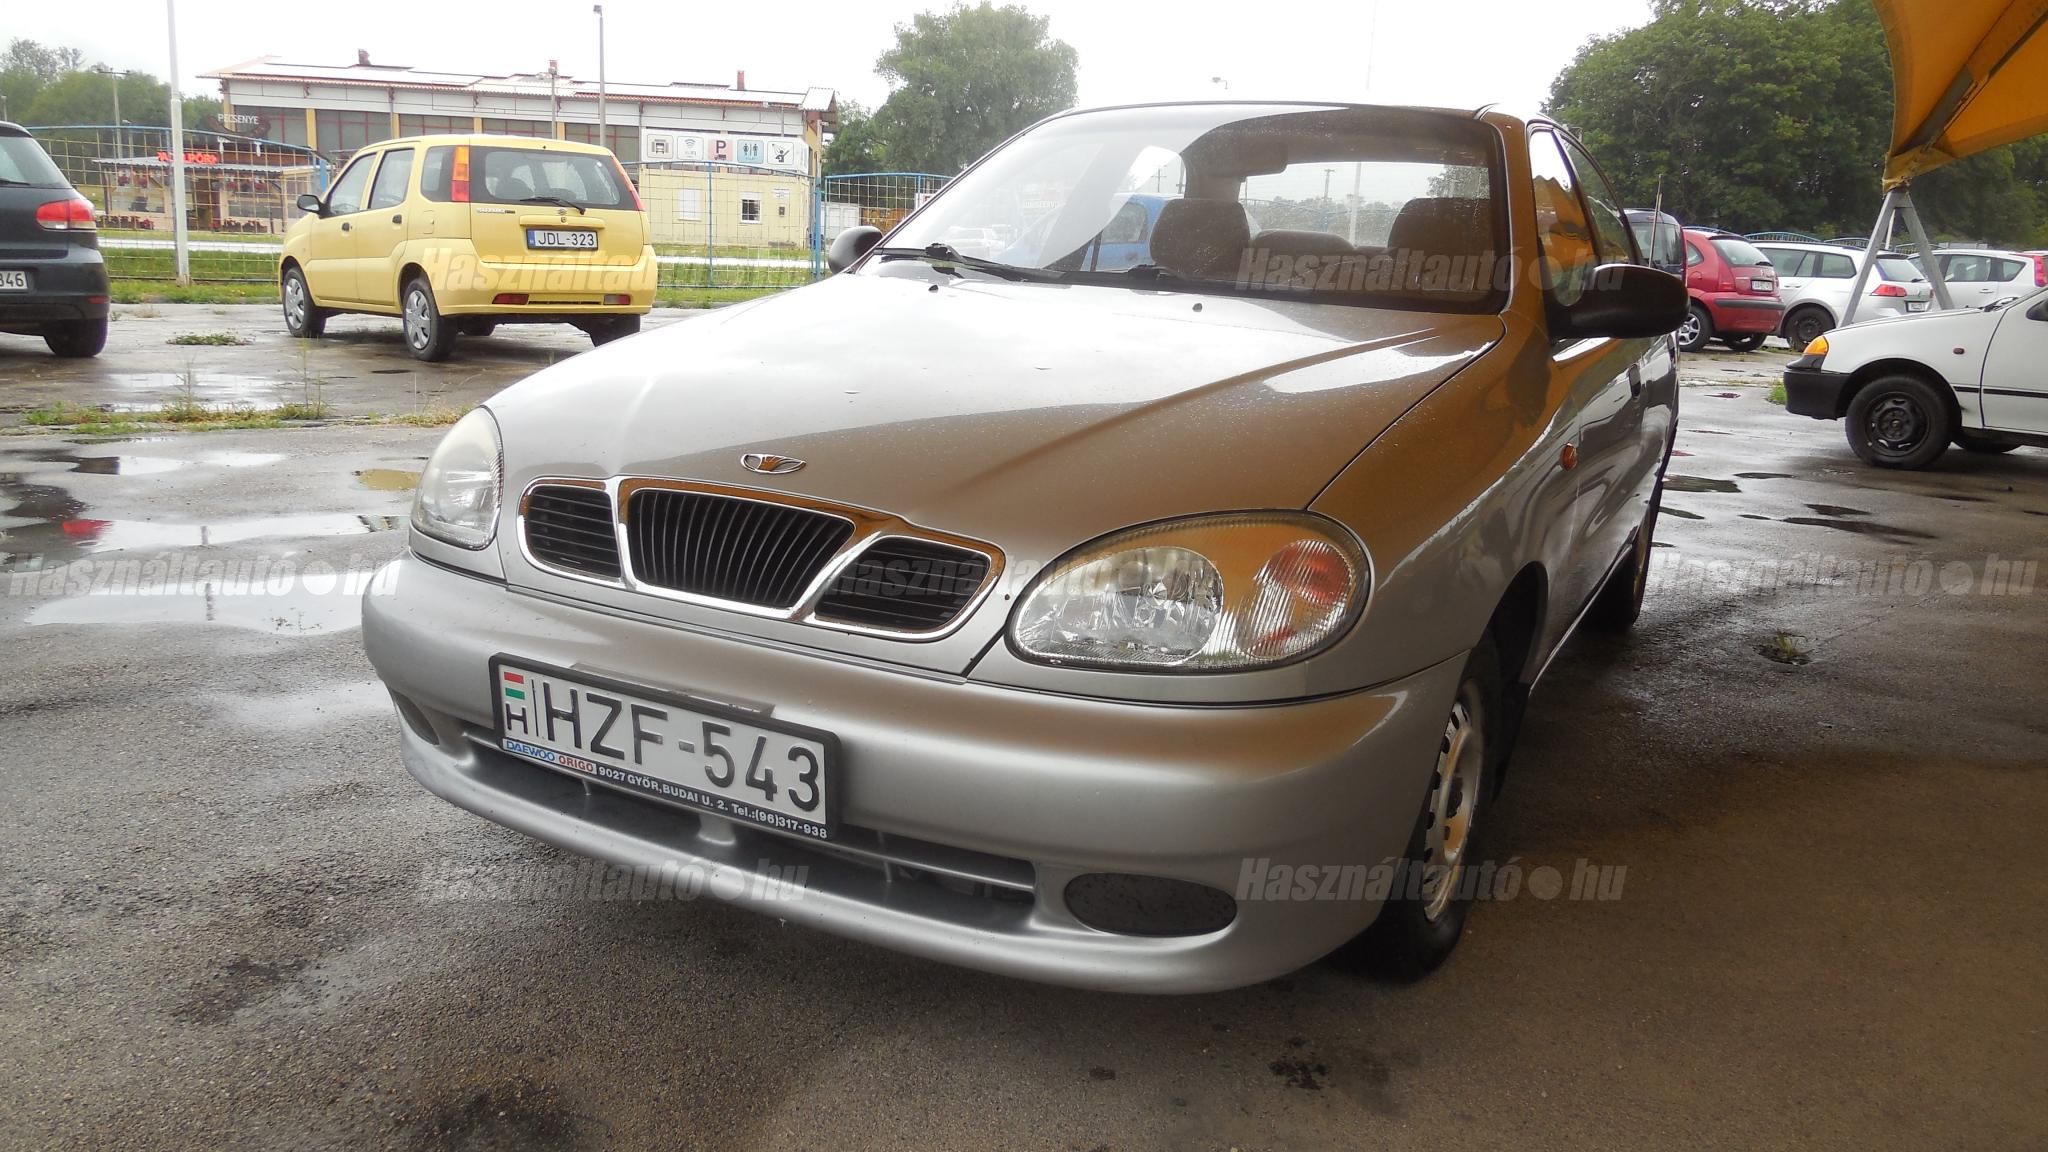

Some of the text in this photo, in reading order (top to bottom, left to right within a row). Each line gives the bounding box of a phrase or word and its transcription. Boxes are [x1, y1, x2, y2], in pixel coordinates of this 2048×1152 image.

[538, 232, 595, 246] JDL-323
[506, 740, 556, 762] DAEWOO
[558, 755, 594, 772] ORIGO
[599, 766, 626, 781] 9027
[701, 794, 715, 807] U.
[717, 799, 729, 811] 2.
[543, 681, 819, 812] HZF-543
